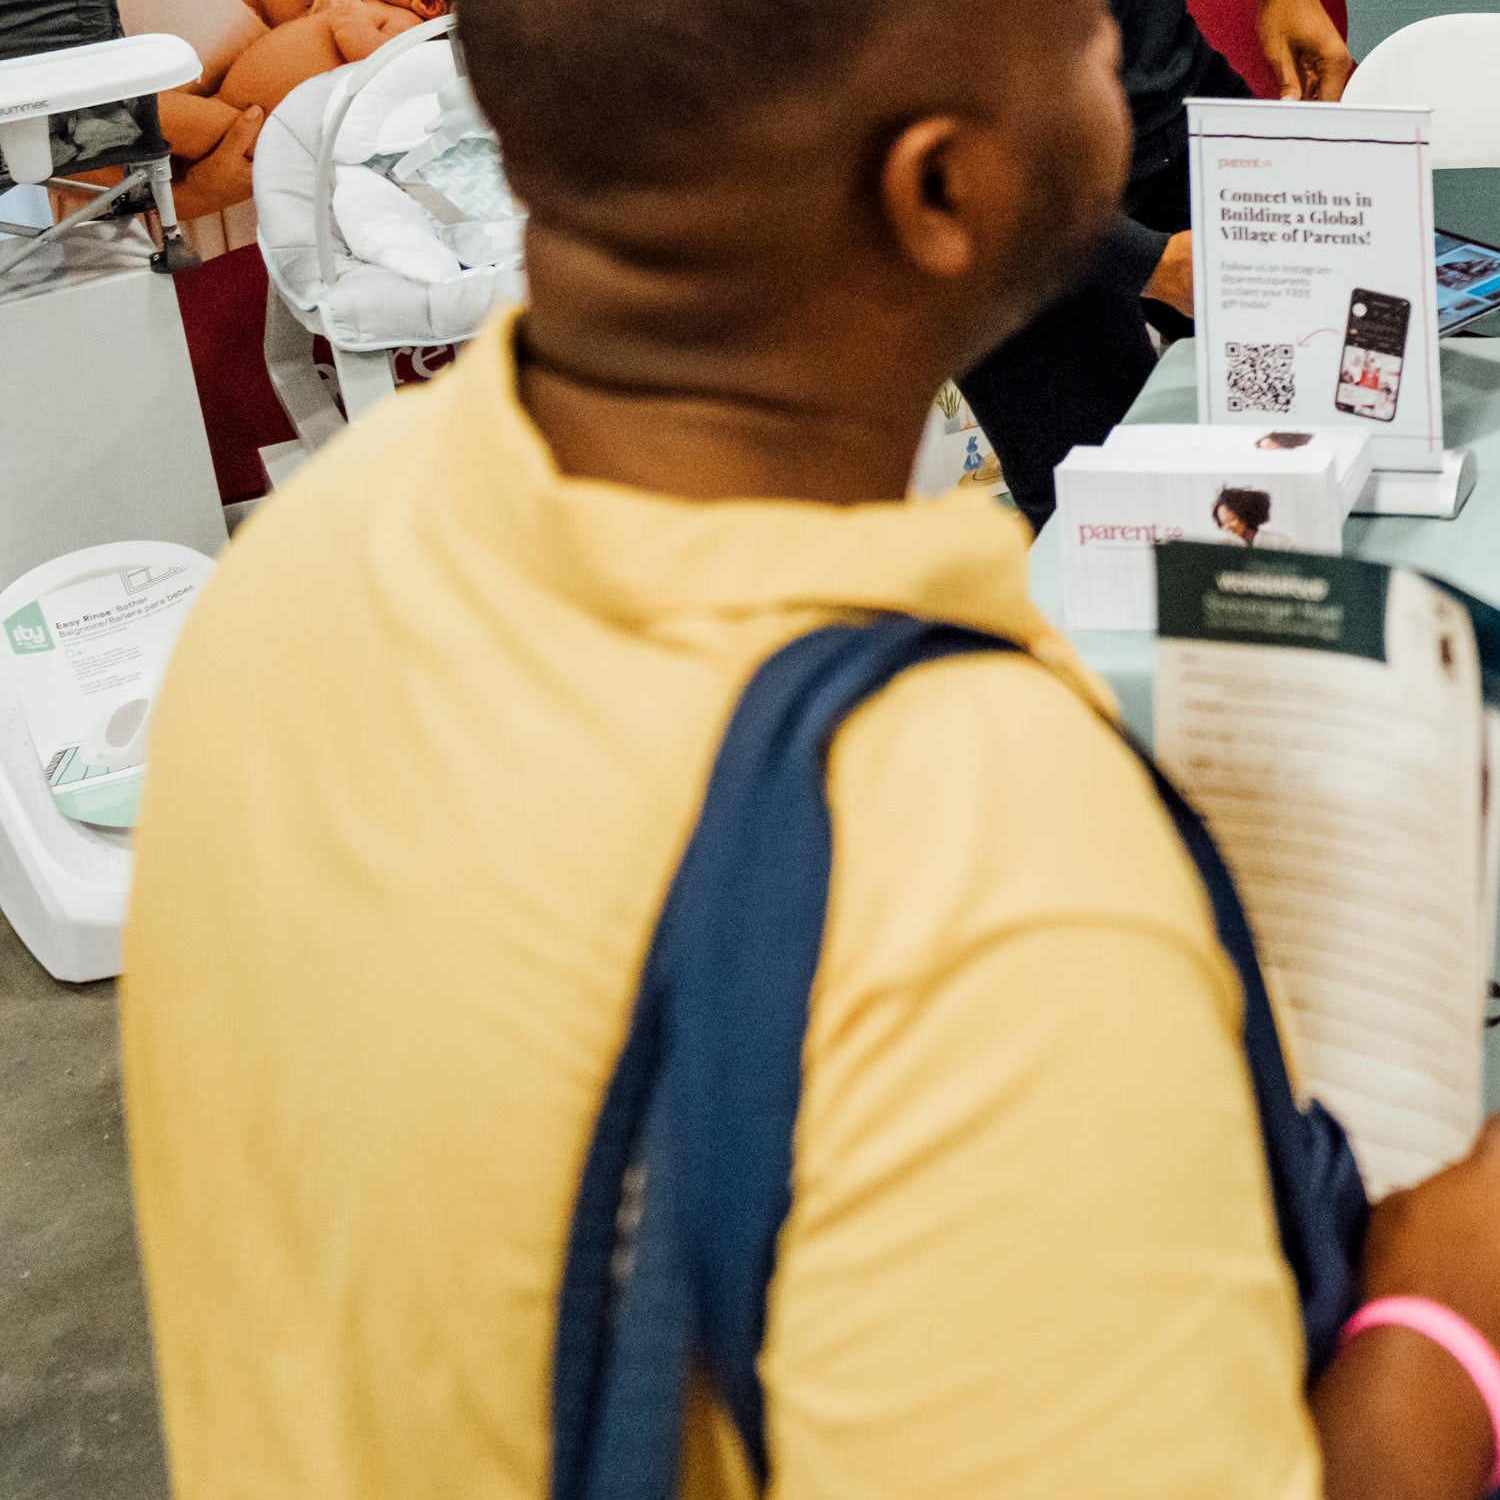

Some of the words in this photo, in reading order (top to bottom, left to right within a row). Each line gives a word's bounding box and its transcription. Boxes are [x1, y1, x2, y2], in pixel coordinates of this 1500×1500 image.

[1219, 187, 1288, 204] Connect
[1291, 190, 1328, 206] with
[1333, 195, 1351, 207] us
[1355, 192, 1373, 208] in
[1220, 207, 1292, 225] Building
[1296, 214, 1305, 224] a
[1309, 210, 1364, 226] Global
[1220, 226, 1277, 244] Village
[1281, 228, 1299, 242] of
[1303, 230, 1371, 245] Parents!
[1079, 523, 1162, 545] parent
[55, 616, 81, 630] Easy
[82, 608, 112, 622] Rinse
[115, 596, 149, 613] Bather
[144, 598, 166, 613] para
